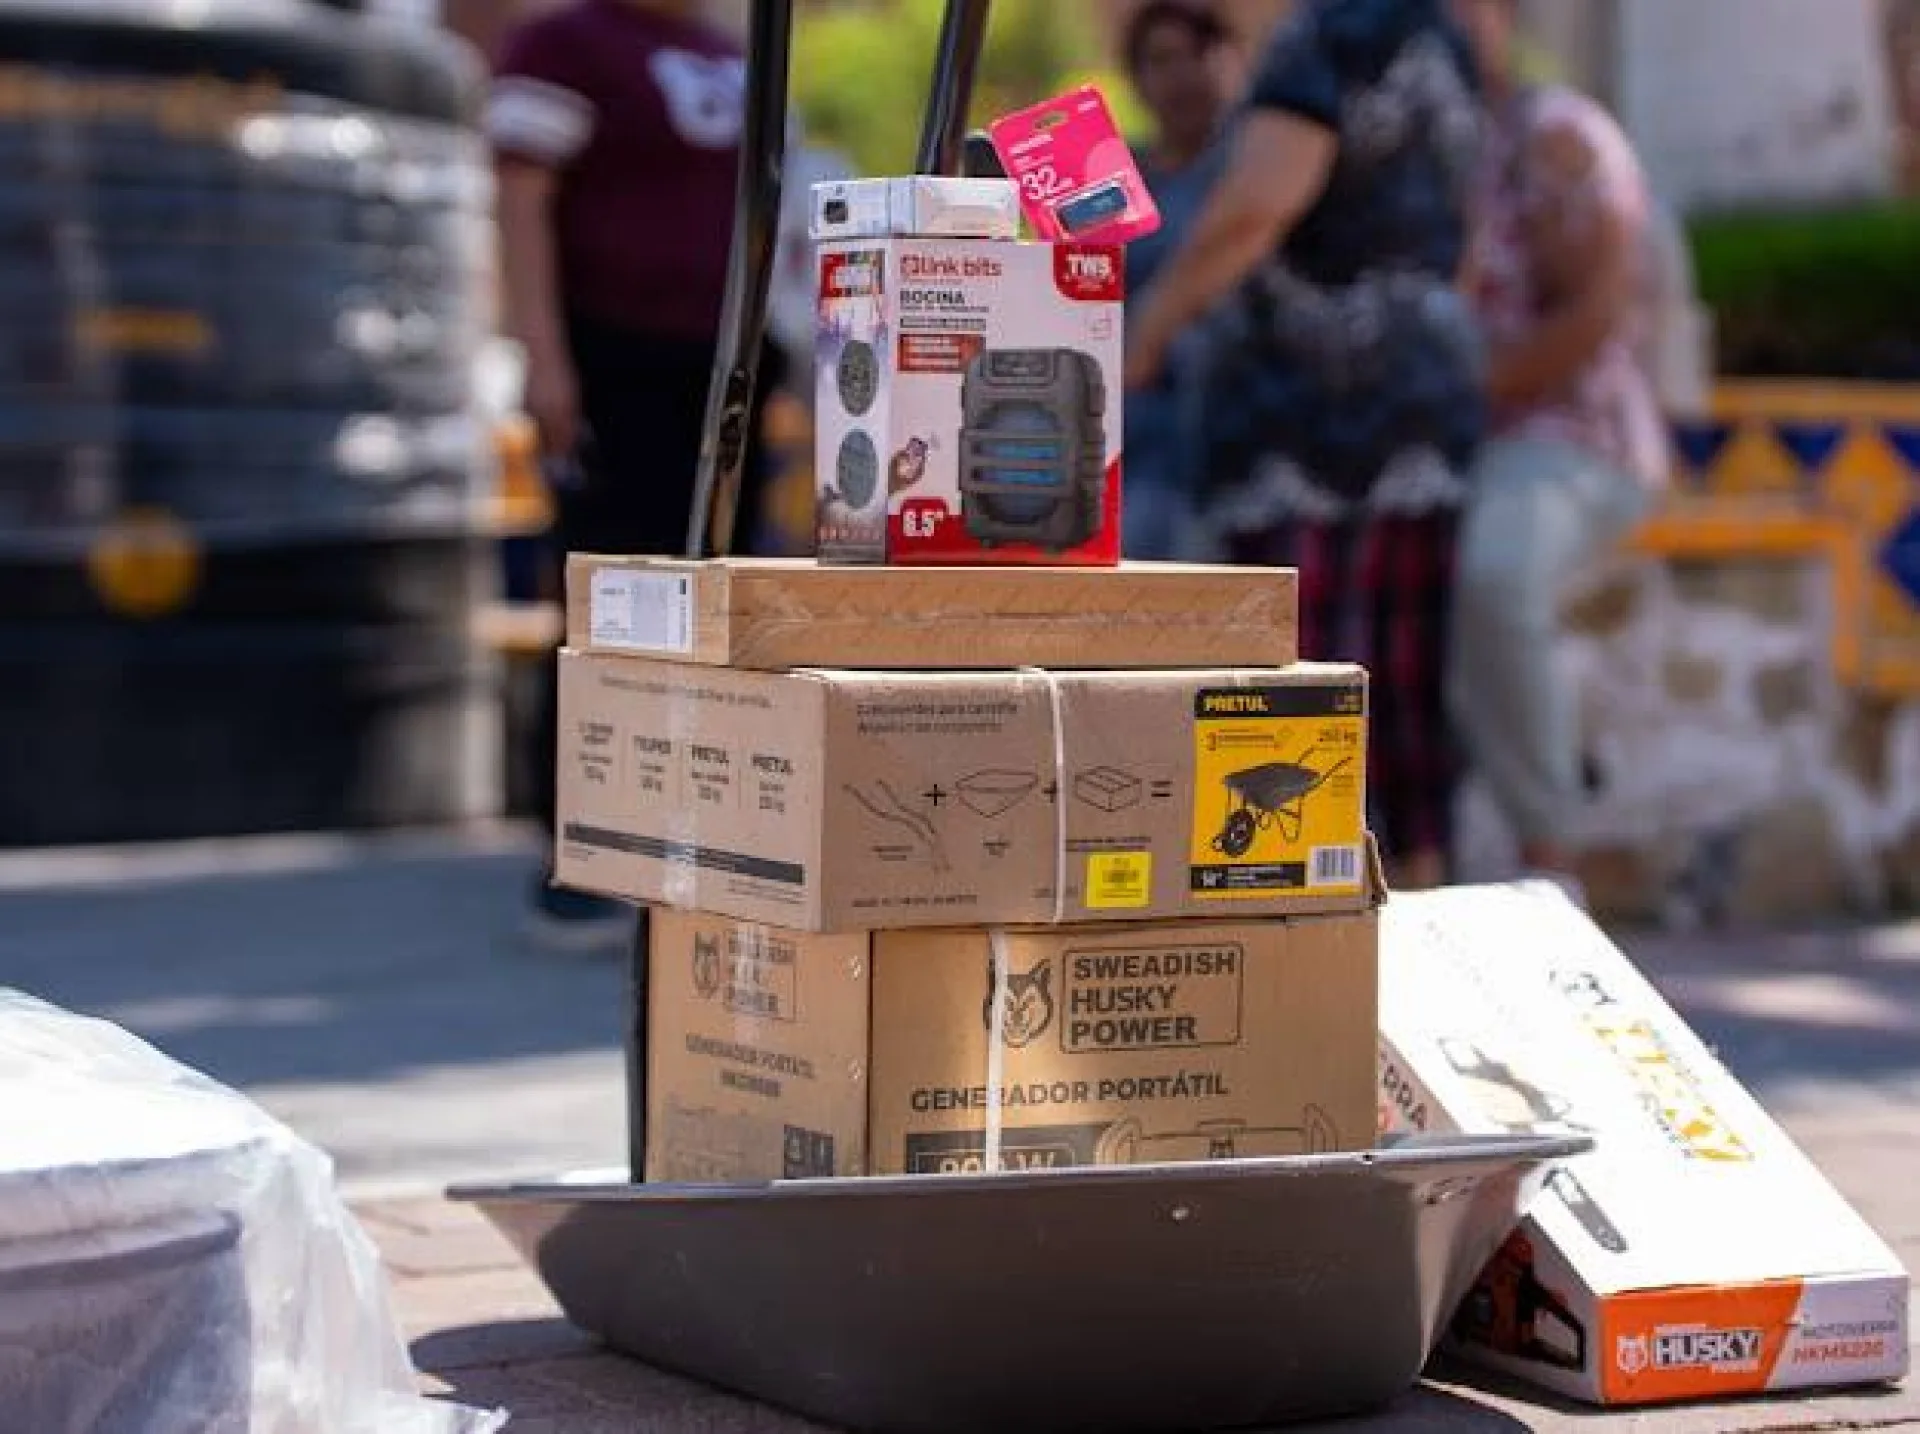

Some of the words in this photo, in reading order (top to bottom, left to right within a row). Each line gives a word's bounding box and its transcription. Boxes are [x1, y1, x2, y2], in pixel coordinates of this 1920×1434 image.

[963, 256, 1001, 276] bits
[900, 290, 965, 305] BOCINA
[1205, 695, 1268, 711] PRETUL
[1073, 951, 1236, 981] SWEADISH
[1071, 984, 1177, 1014] HUSKY
[1071, 1016, 1198, 1046] POWER
[911, 1080, 1089, 1113] GENEADOR
[1099, 1069, 1230, 1101] PORTÁTIL
[1655, 1331, 1757, 1365] HUSKY
